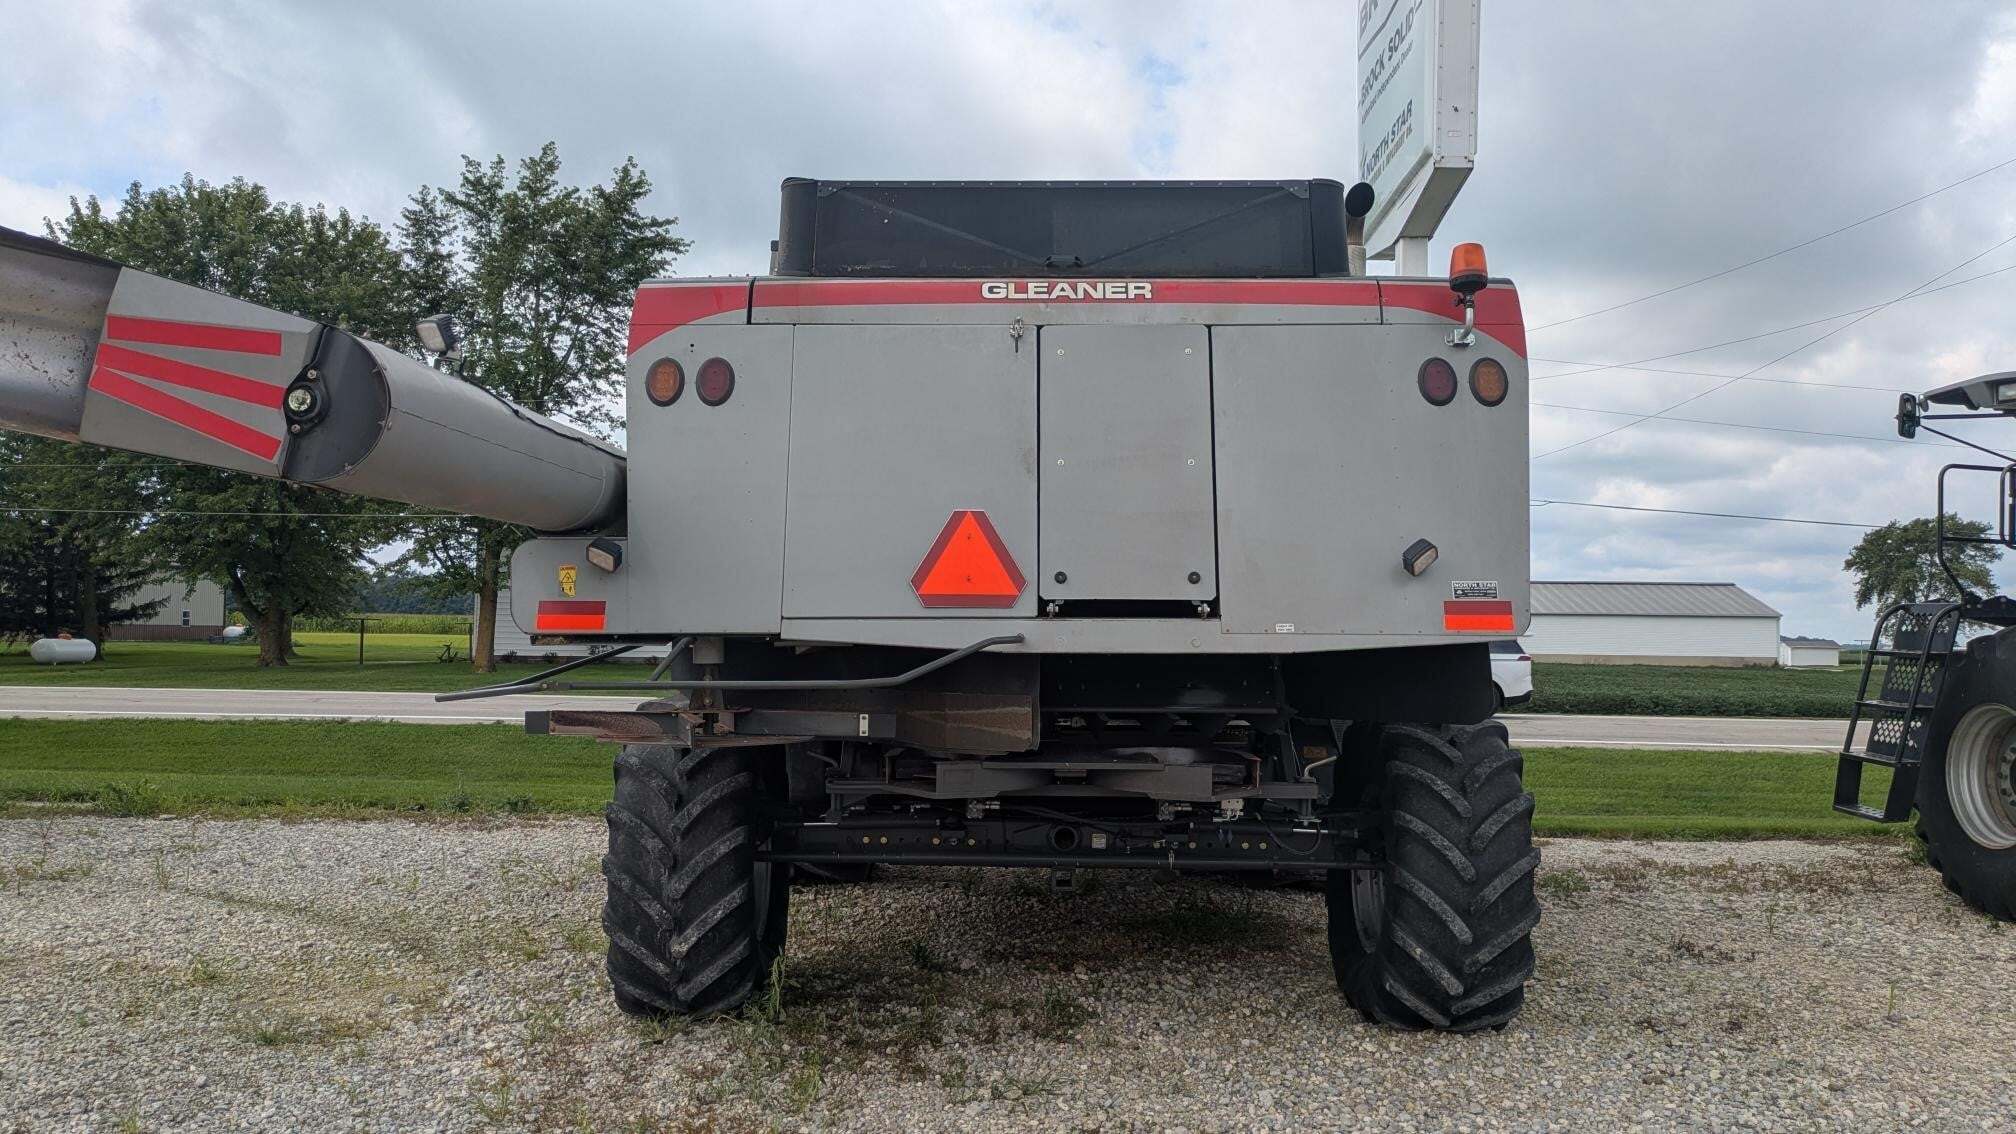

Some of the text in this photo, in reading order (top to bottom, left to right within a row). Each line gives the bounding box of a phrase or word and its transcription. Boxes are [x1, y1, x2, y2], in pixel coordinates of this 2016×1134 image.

[1388, 6, 1414, 62] SOLID
[1365, 131, 1389, 181] NORTH
[1391, 98, 1412, 143] STAR
[981, 282, 1152, 299] GLEANER
